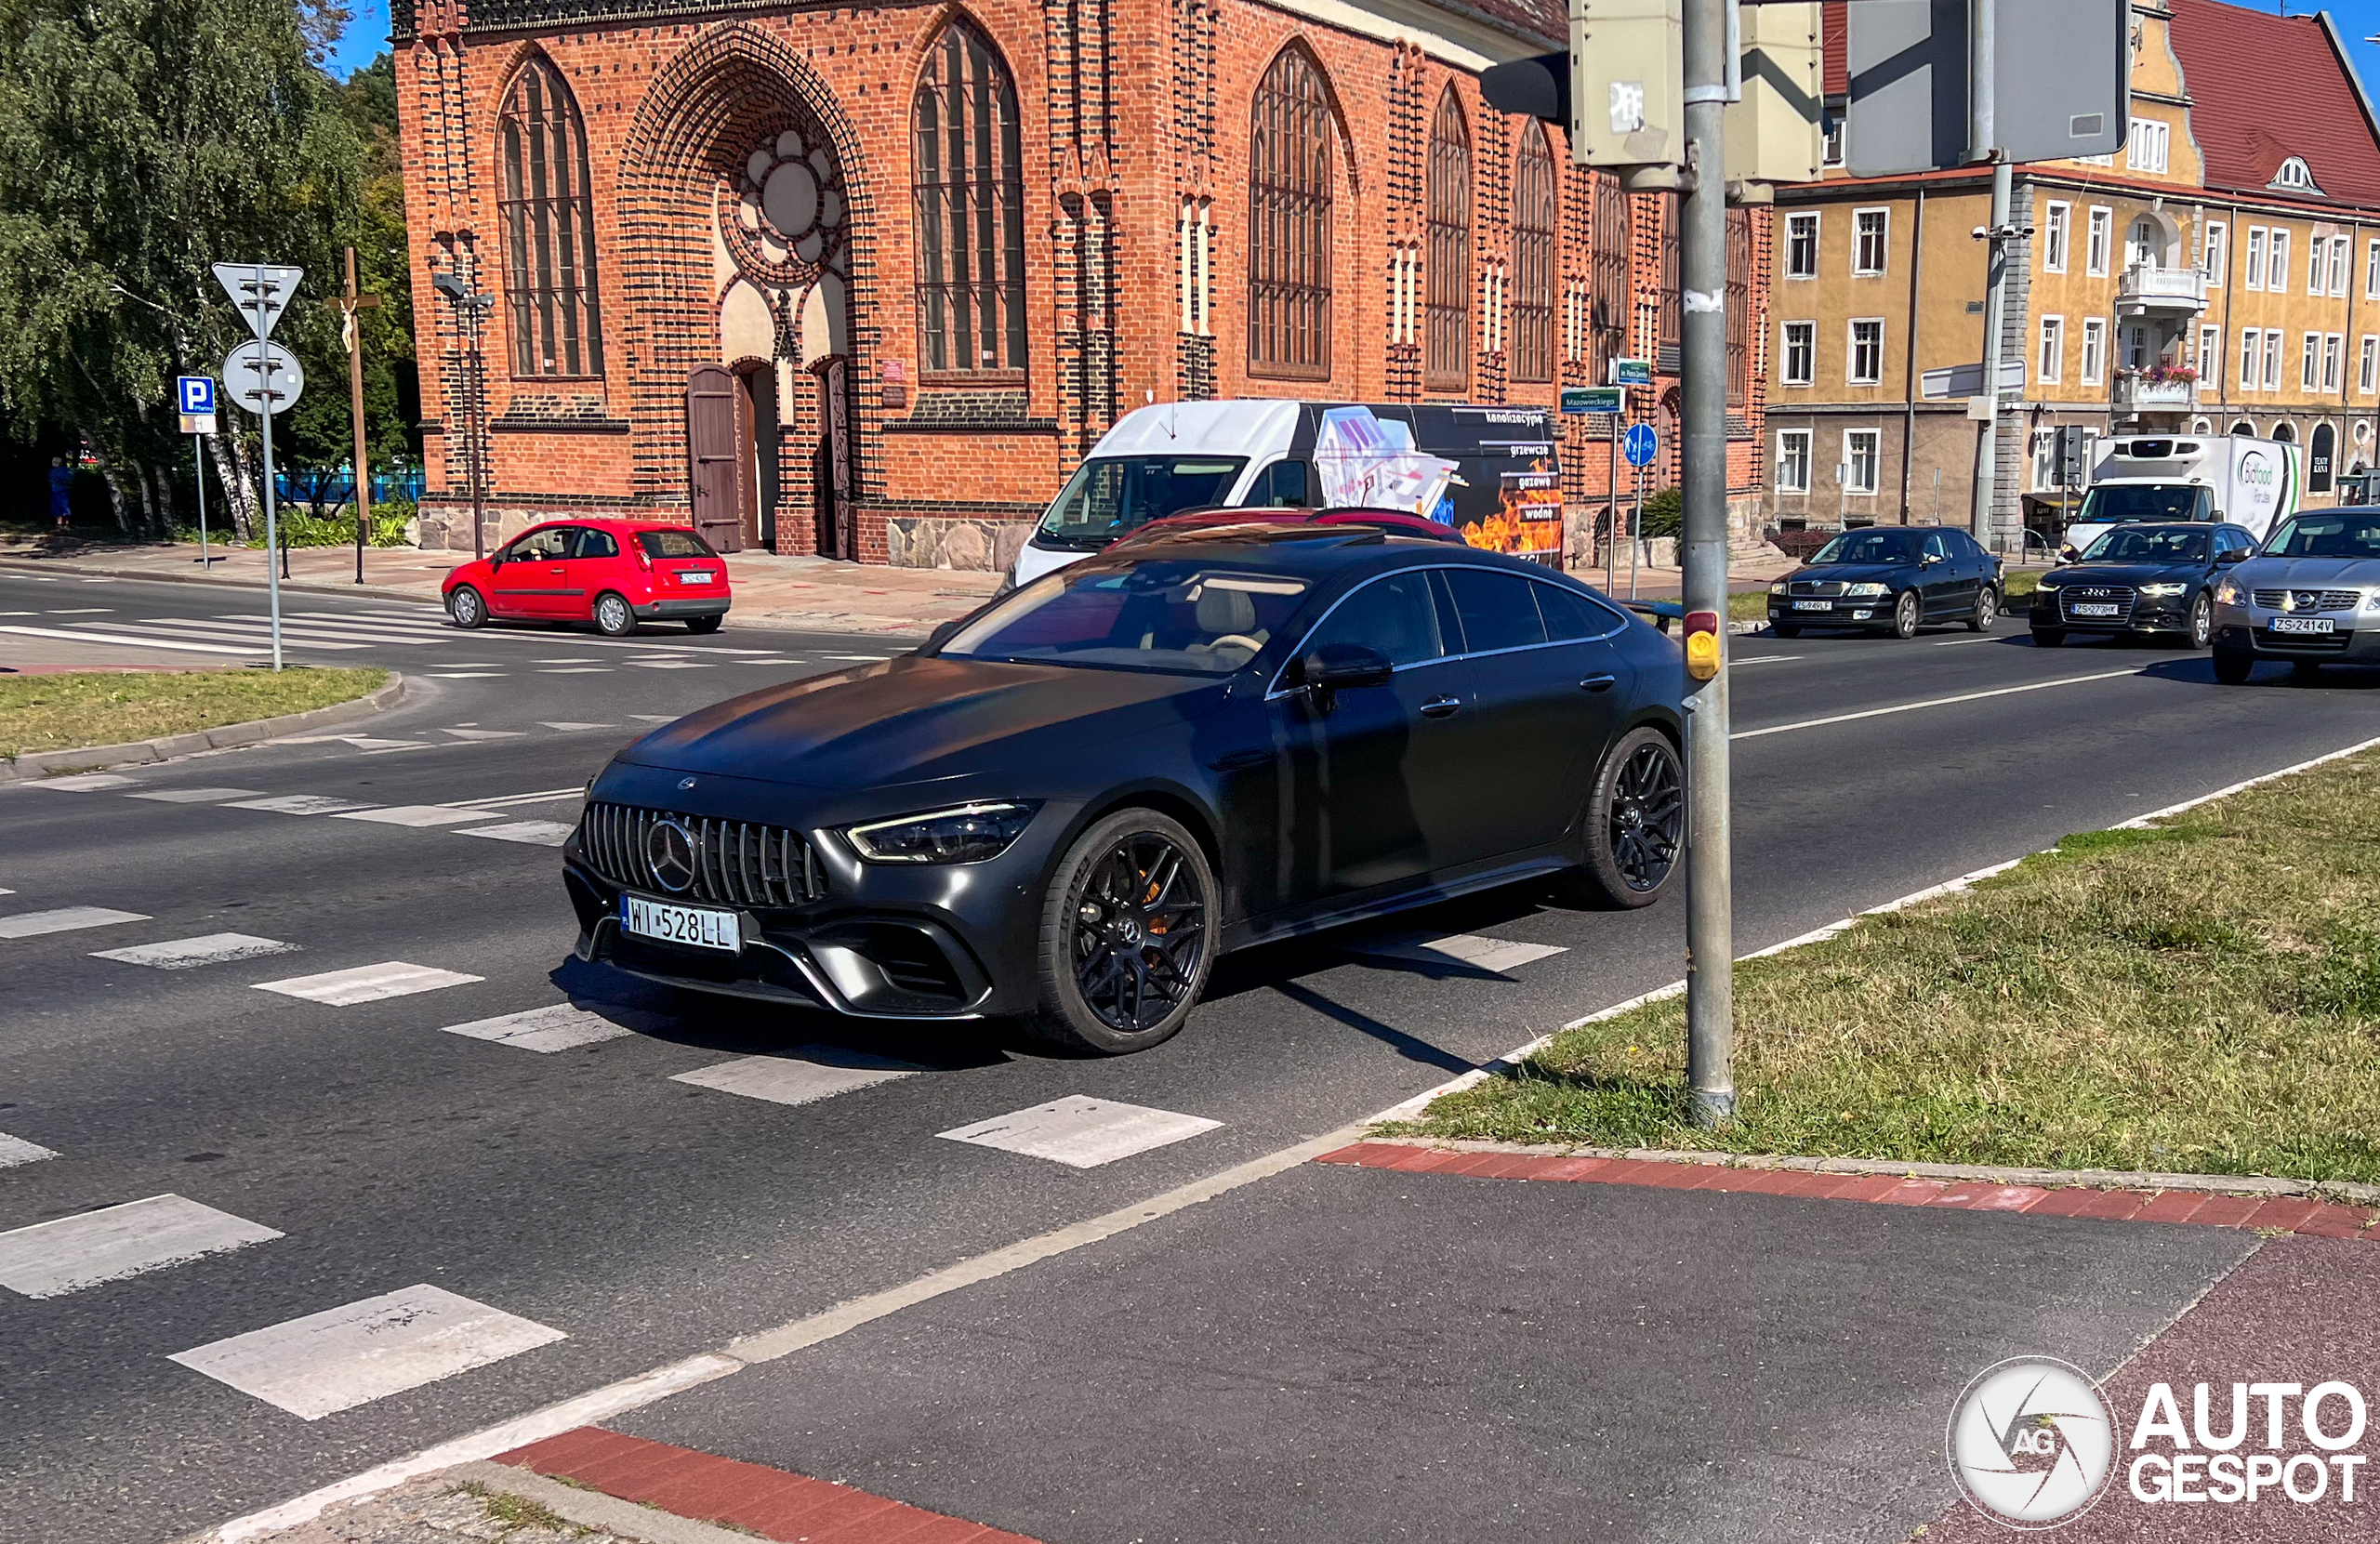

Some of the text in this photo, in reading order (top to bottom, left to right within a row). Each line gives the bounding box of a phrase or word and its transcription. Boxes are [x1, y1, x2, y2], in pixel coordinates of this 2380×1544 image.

[186, 381, 207, 410] P
[1566, 398, 1615, 407] Mazowieckiego
[1486, 410, 1544, 427] kanalizacyjne
[1511, 445, 1549, 457] grzewcze
[1519, 477, 1551, 490] gazowe
[1526, 507, 1553, 519] wodne
[2295, 620, 2332, 631] 2414V
[632, 900, 730, 946] WI 528LL
